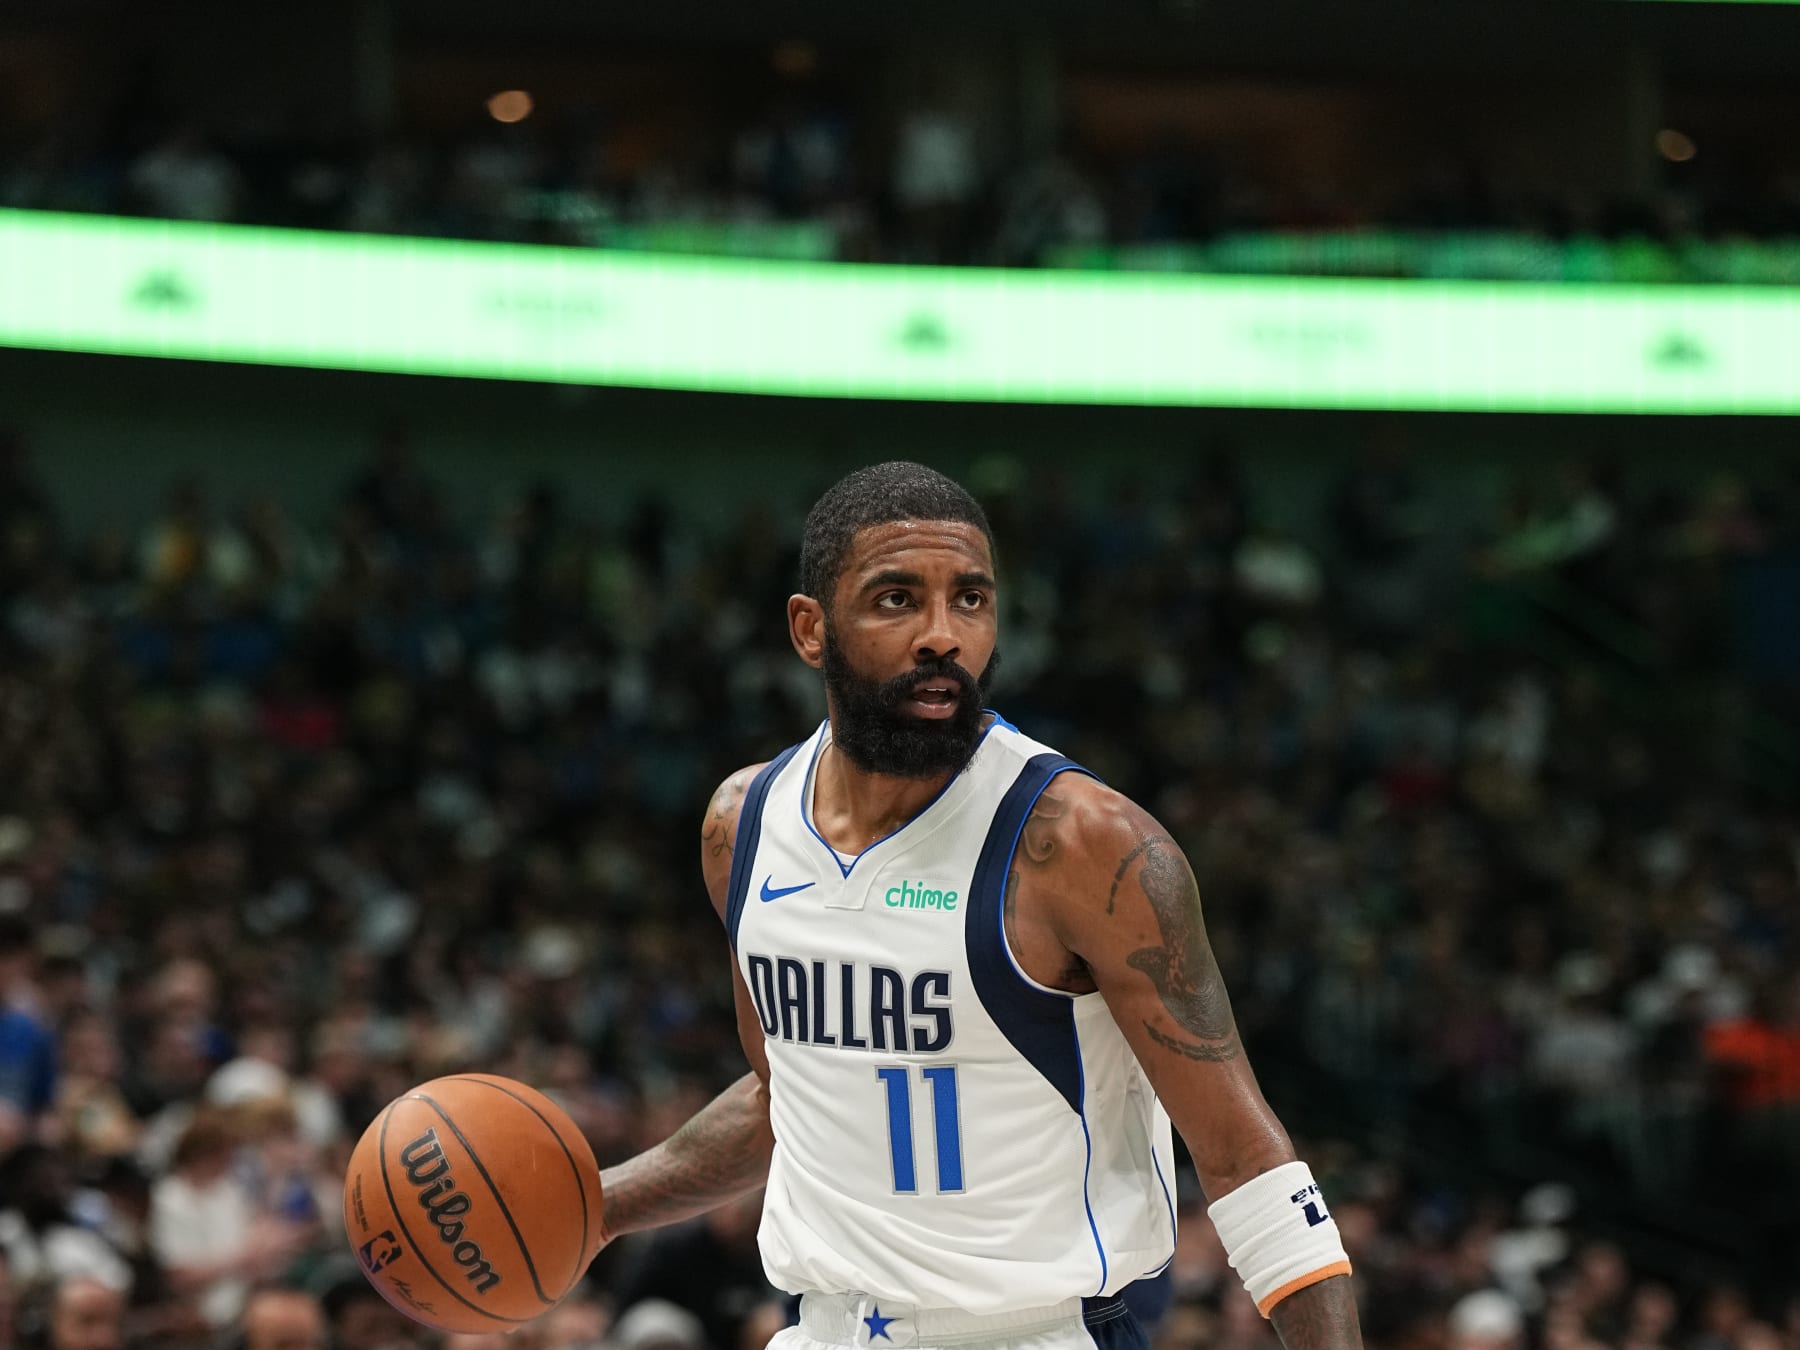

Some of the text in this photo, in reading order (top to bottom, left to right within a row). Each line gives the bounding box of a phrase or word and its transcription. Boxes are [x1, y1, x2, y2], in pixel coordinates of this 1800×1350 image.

[885, 880, 958, 911] chime
[747, 954, 955, 1056] DALLAS
[874, 1063, 968, 1196] 11
[401, 1127, 500, 1294] Wilson
